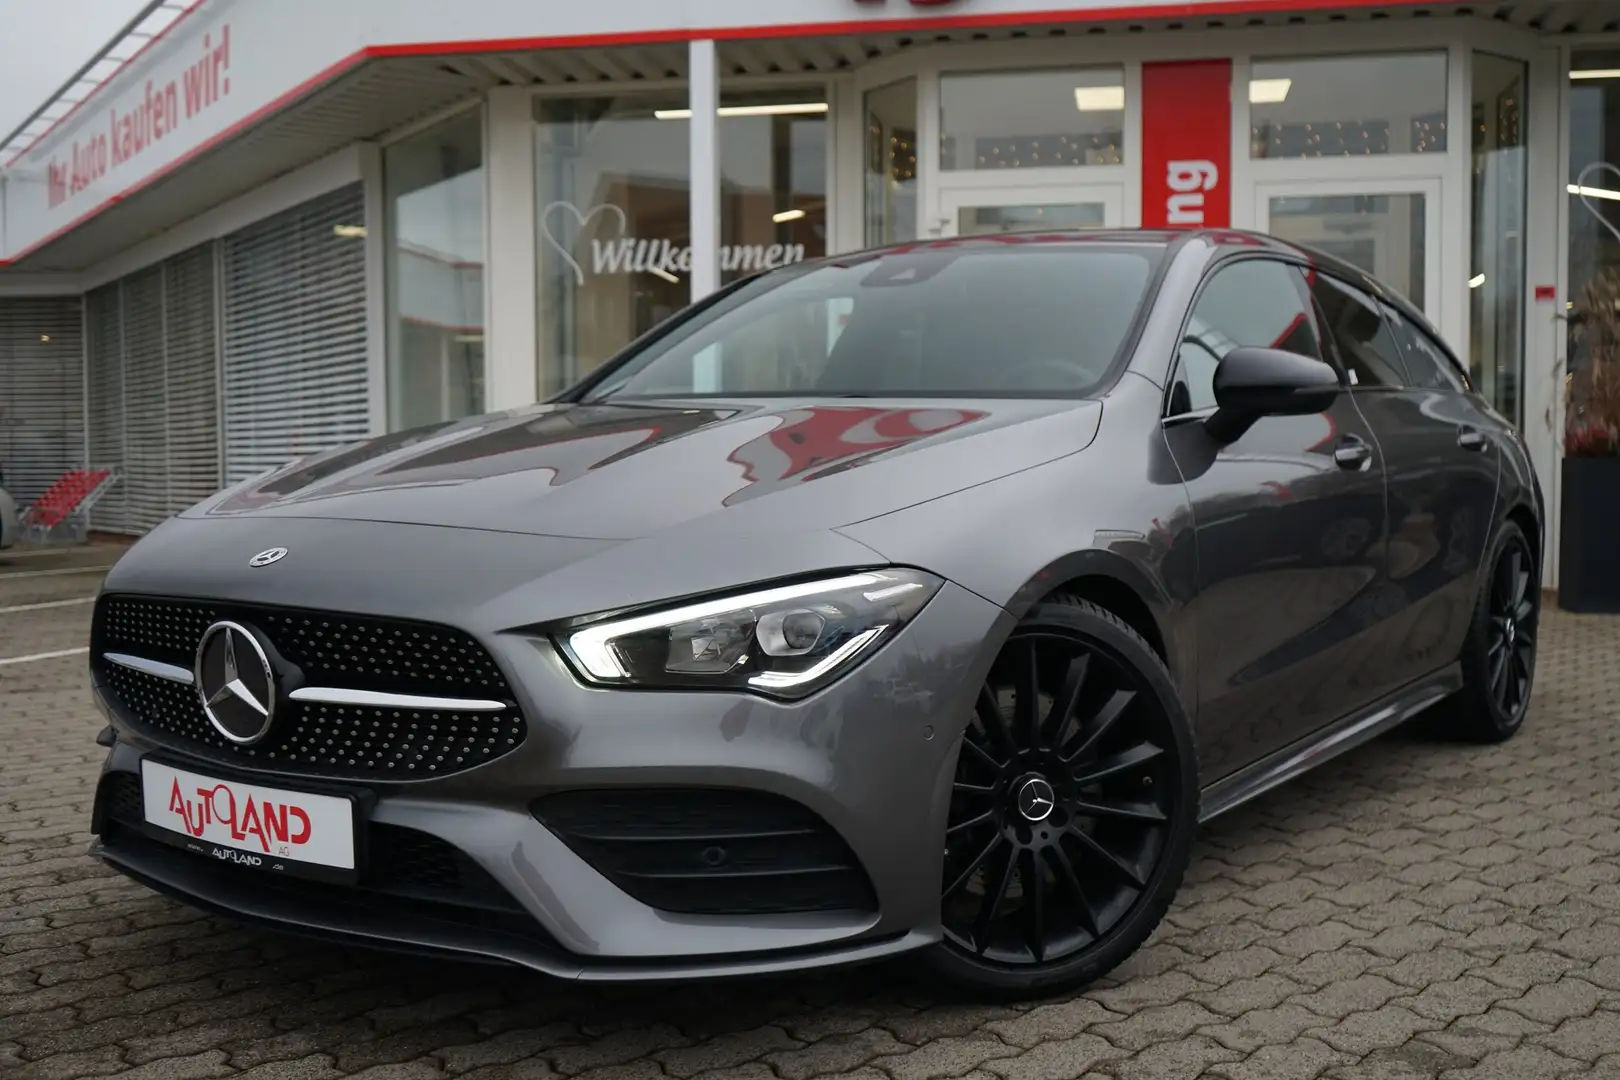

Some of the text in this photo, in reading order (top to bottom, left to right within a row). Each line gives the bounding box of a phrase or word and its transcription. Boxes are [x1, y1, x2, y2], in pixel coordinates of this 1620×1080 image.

[48, 23, 230, 209] Ihr Auto kaufen wir!
[1166, 160, 1219, 226] ng
[169, 776, 311, 853] AUTOLAND
[212, 847, 262, 865] AUTOLAND
[278, 846, 290, 857] AG
